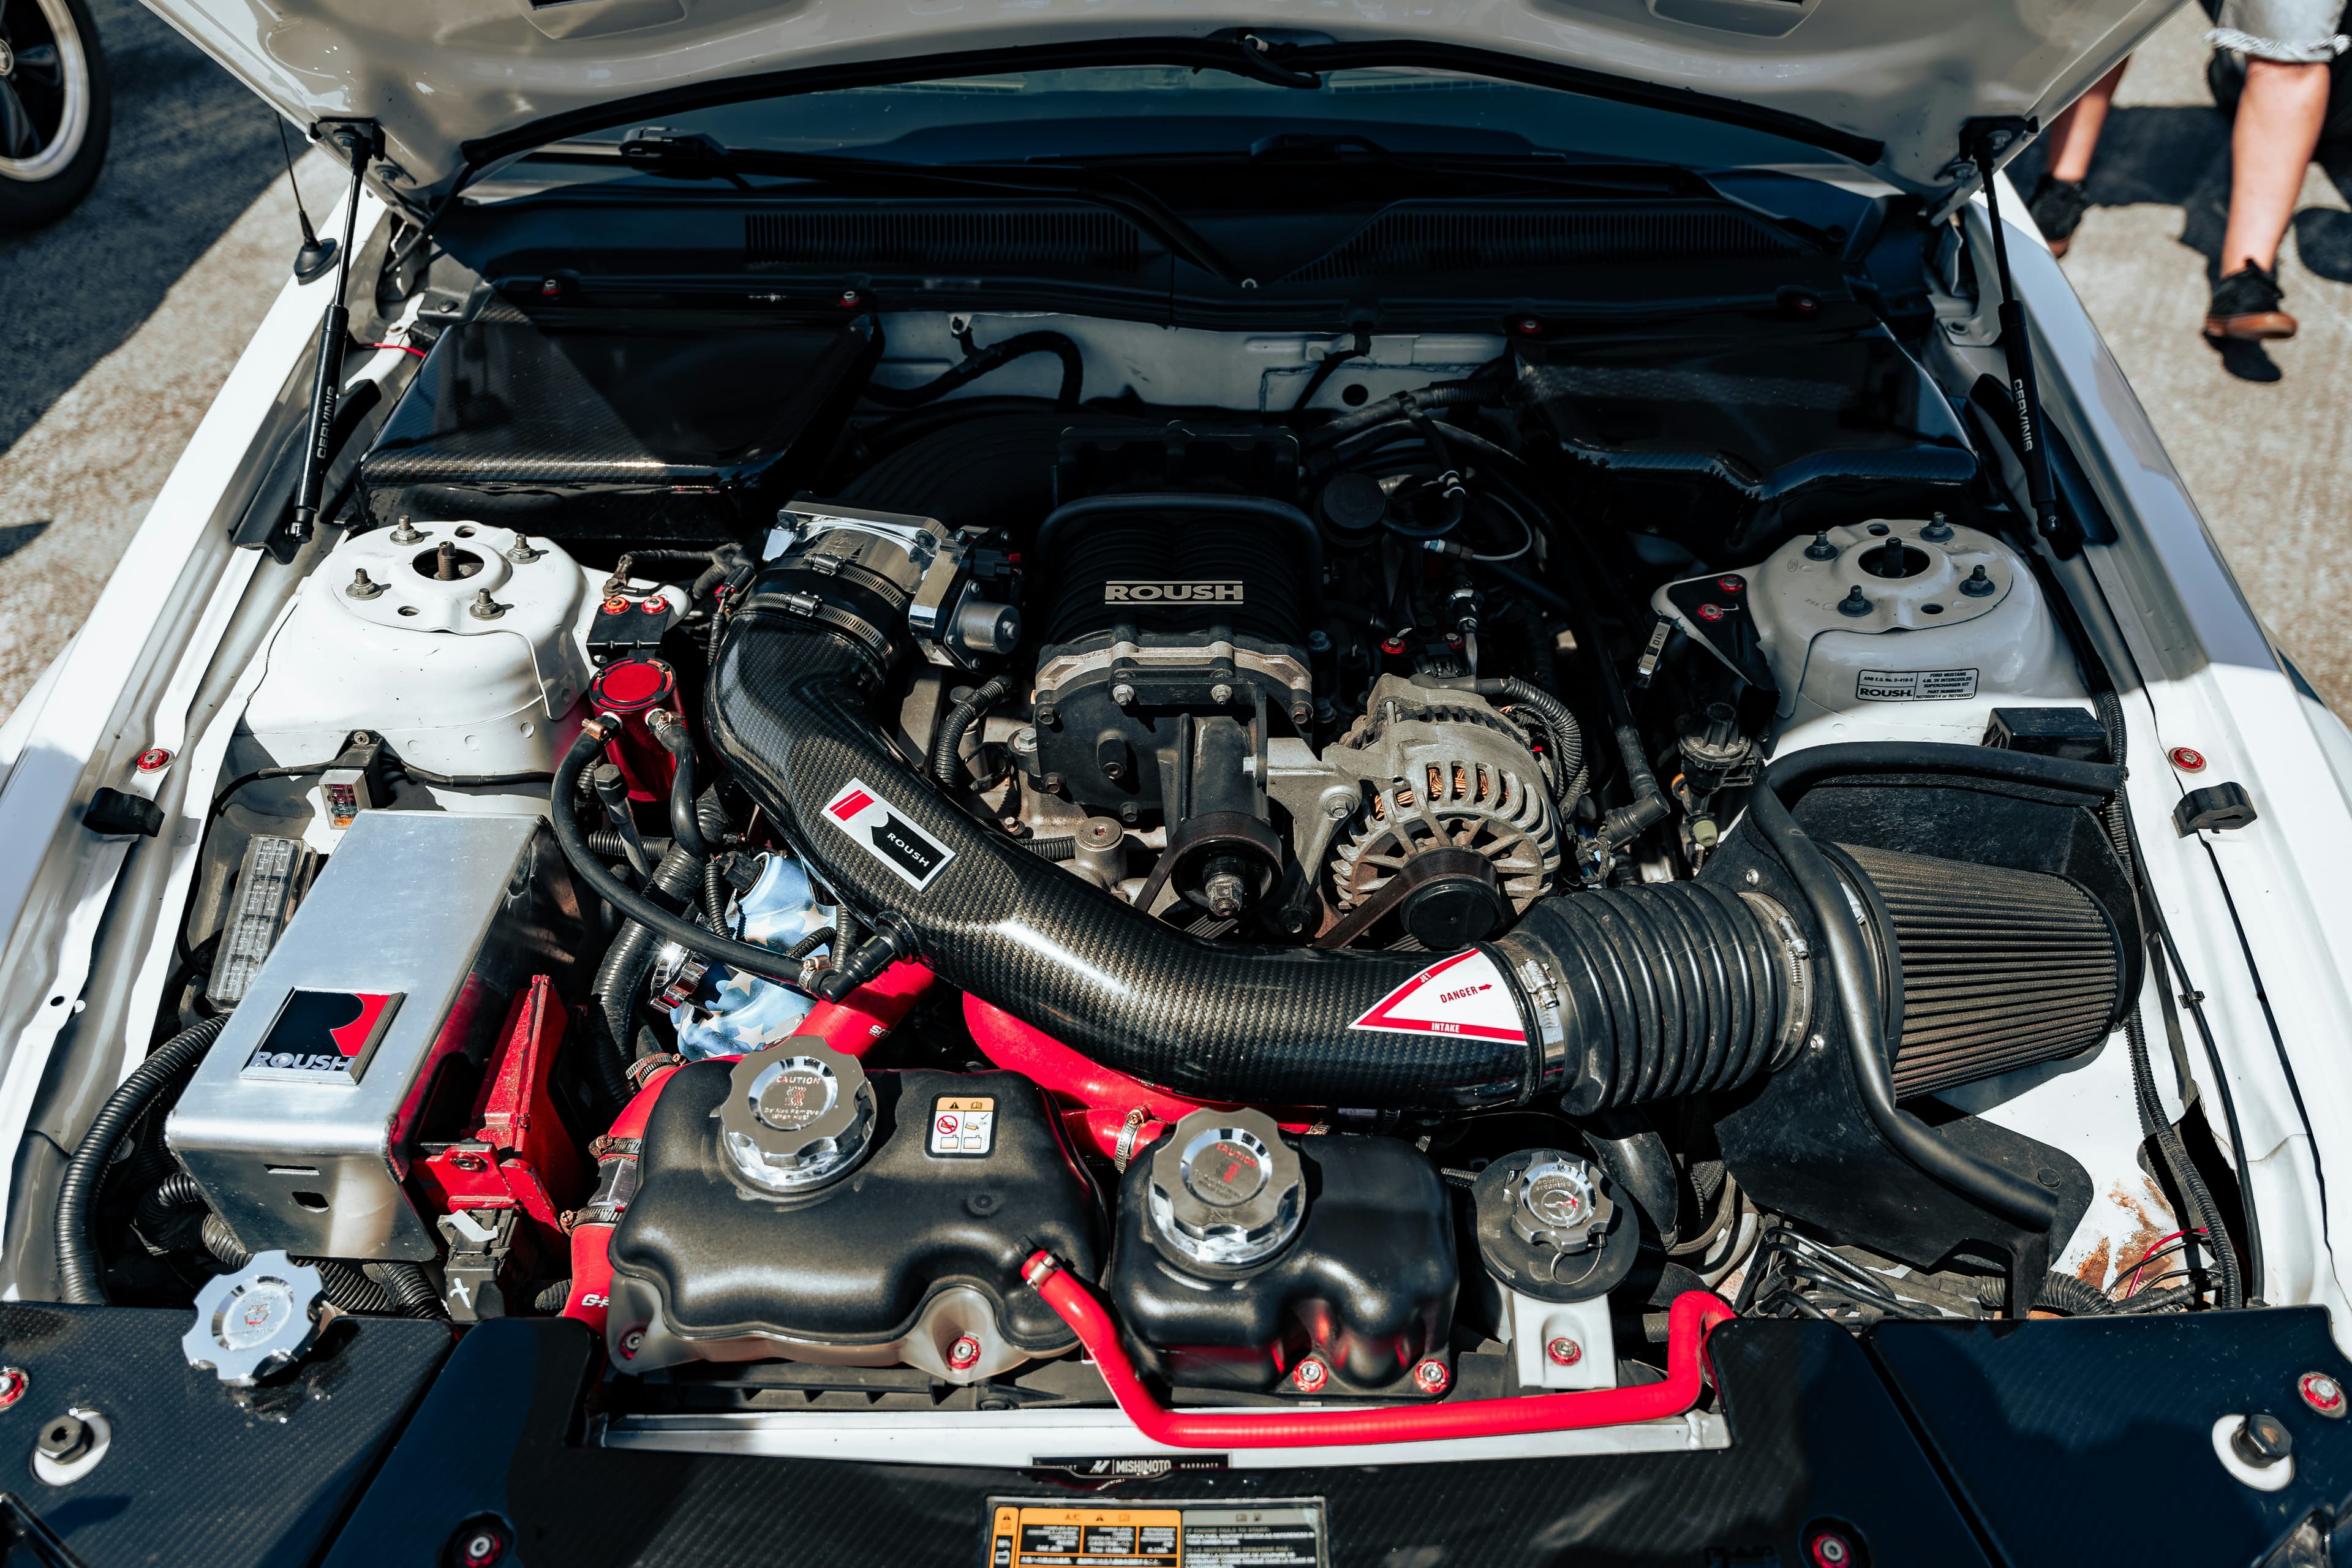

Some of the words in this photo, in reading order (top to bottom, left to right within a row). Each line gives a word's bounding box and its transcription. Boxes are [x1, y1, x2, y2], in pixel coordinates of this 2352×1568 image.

[317, 385, 336, 459] CERVINIS
[2013, 378, 2034, 452] CERVINIS
[1104, 585, 1244, 600] ROUSH
[887, 832, 930, 867] ROUSH
[1419, 972, 1432, 984] JET
[1440, 986, 1479, 1003] DANGER
[1431, 1022, 1460, 1033] INTAKE
[249, 1051, 358, 1072] ROUSH
[775, 1076, 821, 1085] CAUTION
[1215, 1142, 1257, 1168] CAUTION
[1115, 1459, 1172, 1474] MISHIMOTO
